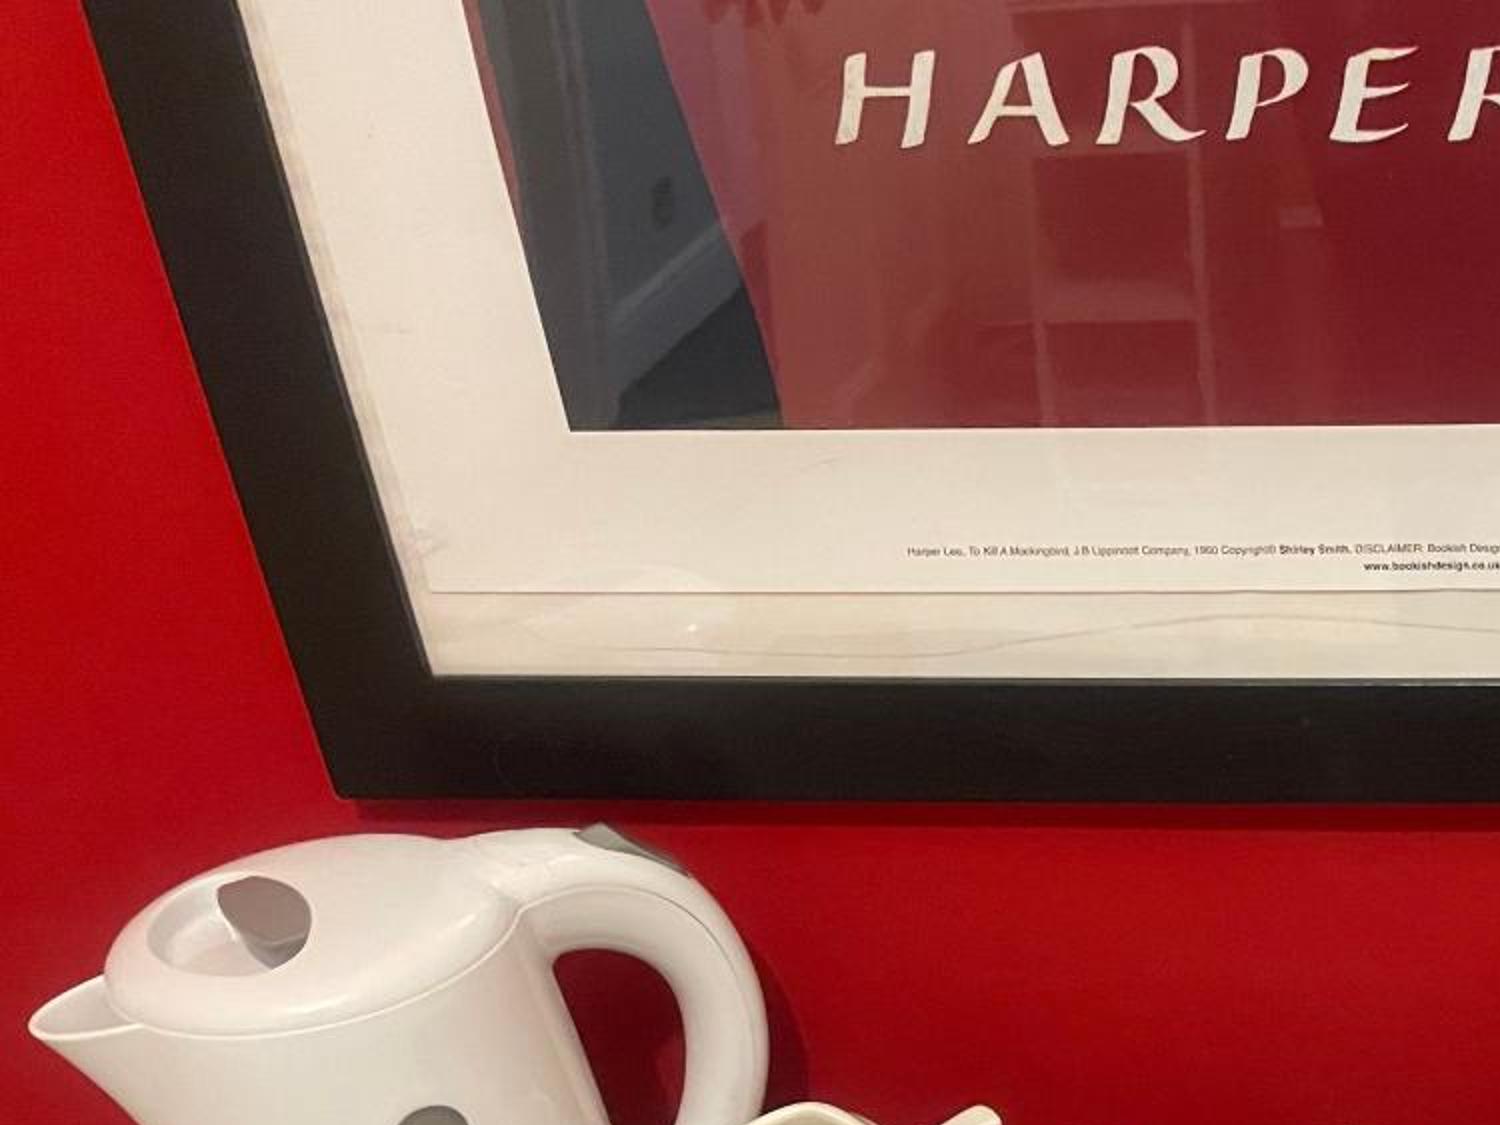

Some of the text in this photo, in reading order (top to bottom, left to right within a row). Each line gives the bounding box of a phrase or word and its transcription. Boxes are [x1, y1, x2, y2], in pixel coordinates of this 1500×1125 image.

[968, 545, 981, 557] To
[1279, 544, 1315, 556] Shirley
[1427, 543, 1467, 553] Bookish
[1362, 561, 1500, 573] www.bookishdesign.co.uk
